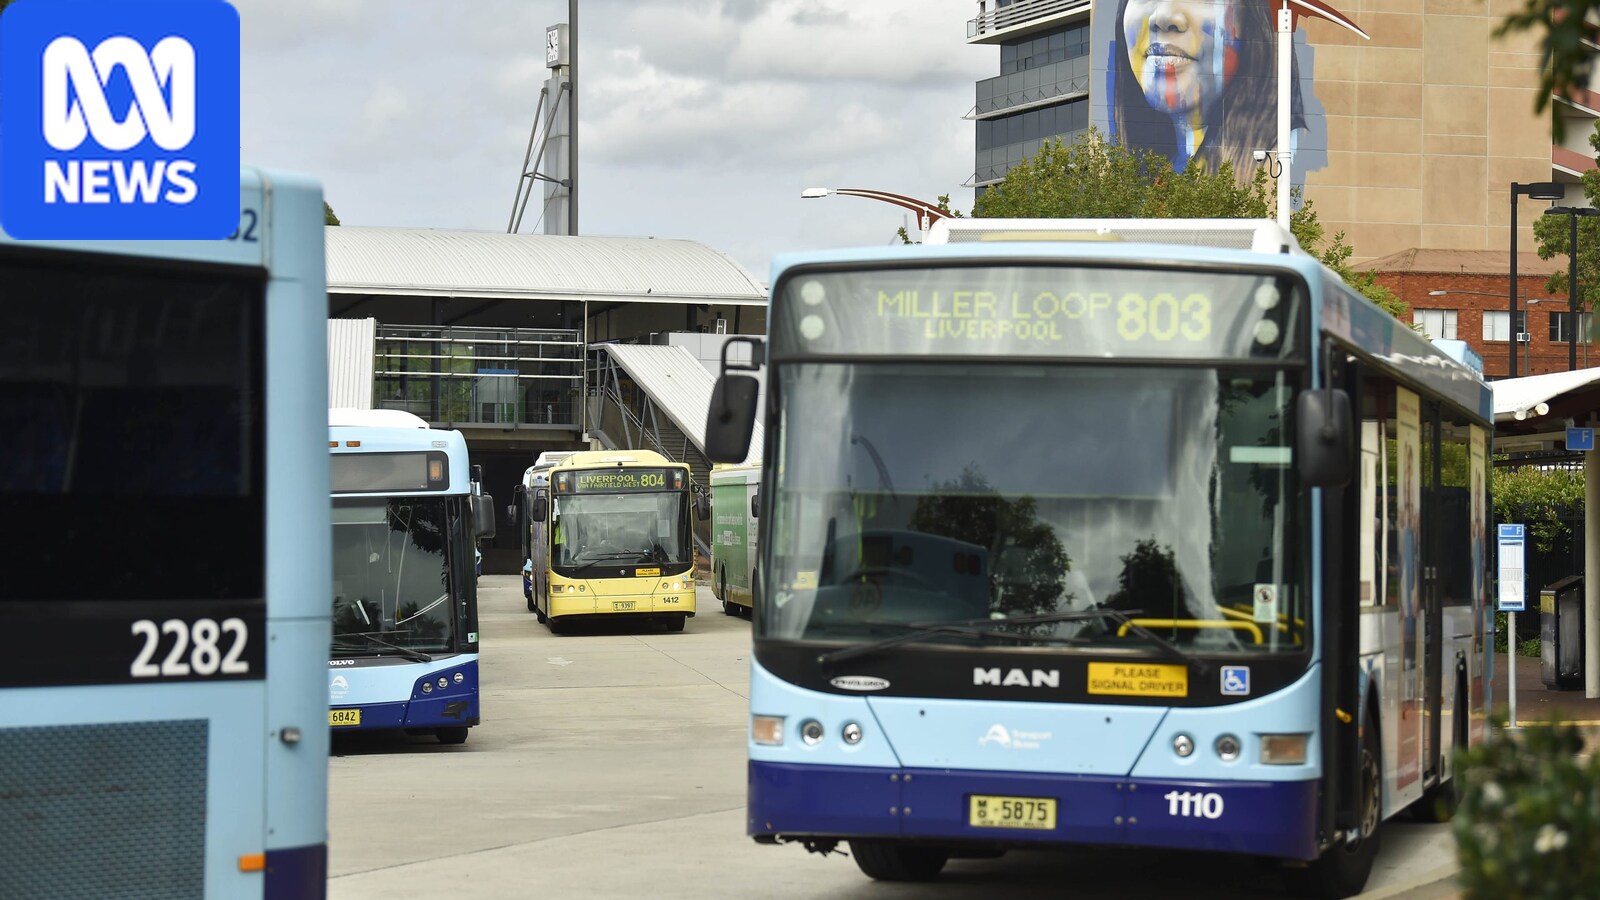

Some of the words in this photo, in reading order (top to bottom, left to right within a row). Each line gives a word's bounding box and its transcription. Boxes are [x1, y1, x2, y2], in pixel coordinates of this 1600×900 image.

[877, 289, 998, 319] MILLER
[1011, 291, 1112, 319] LOOP
[1117, 292, 1211, 341] 803
[925, 319, 1062, 340] LIVERPOOL
[580, 474, 637, 484] LIVERPOOL
[640, 473, 665, 487] 804
[663, 596, 679, 604] 1412
[130, 618, 249, 677] 2282
[973, 667, 1060, 688] MAN
[1114, 667, 1161, 679] PLEASE
[1091, 680, 1135, 691] SIGNAL
[1138, 680, 1185, 692] DRIVER
[332, 711, 356, 722] 6842
[1163, 790, 1224, 820] 1110
